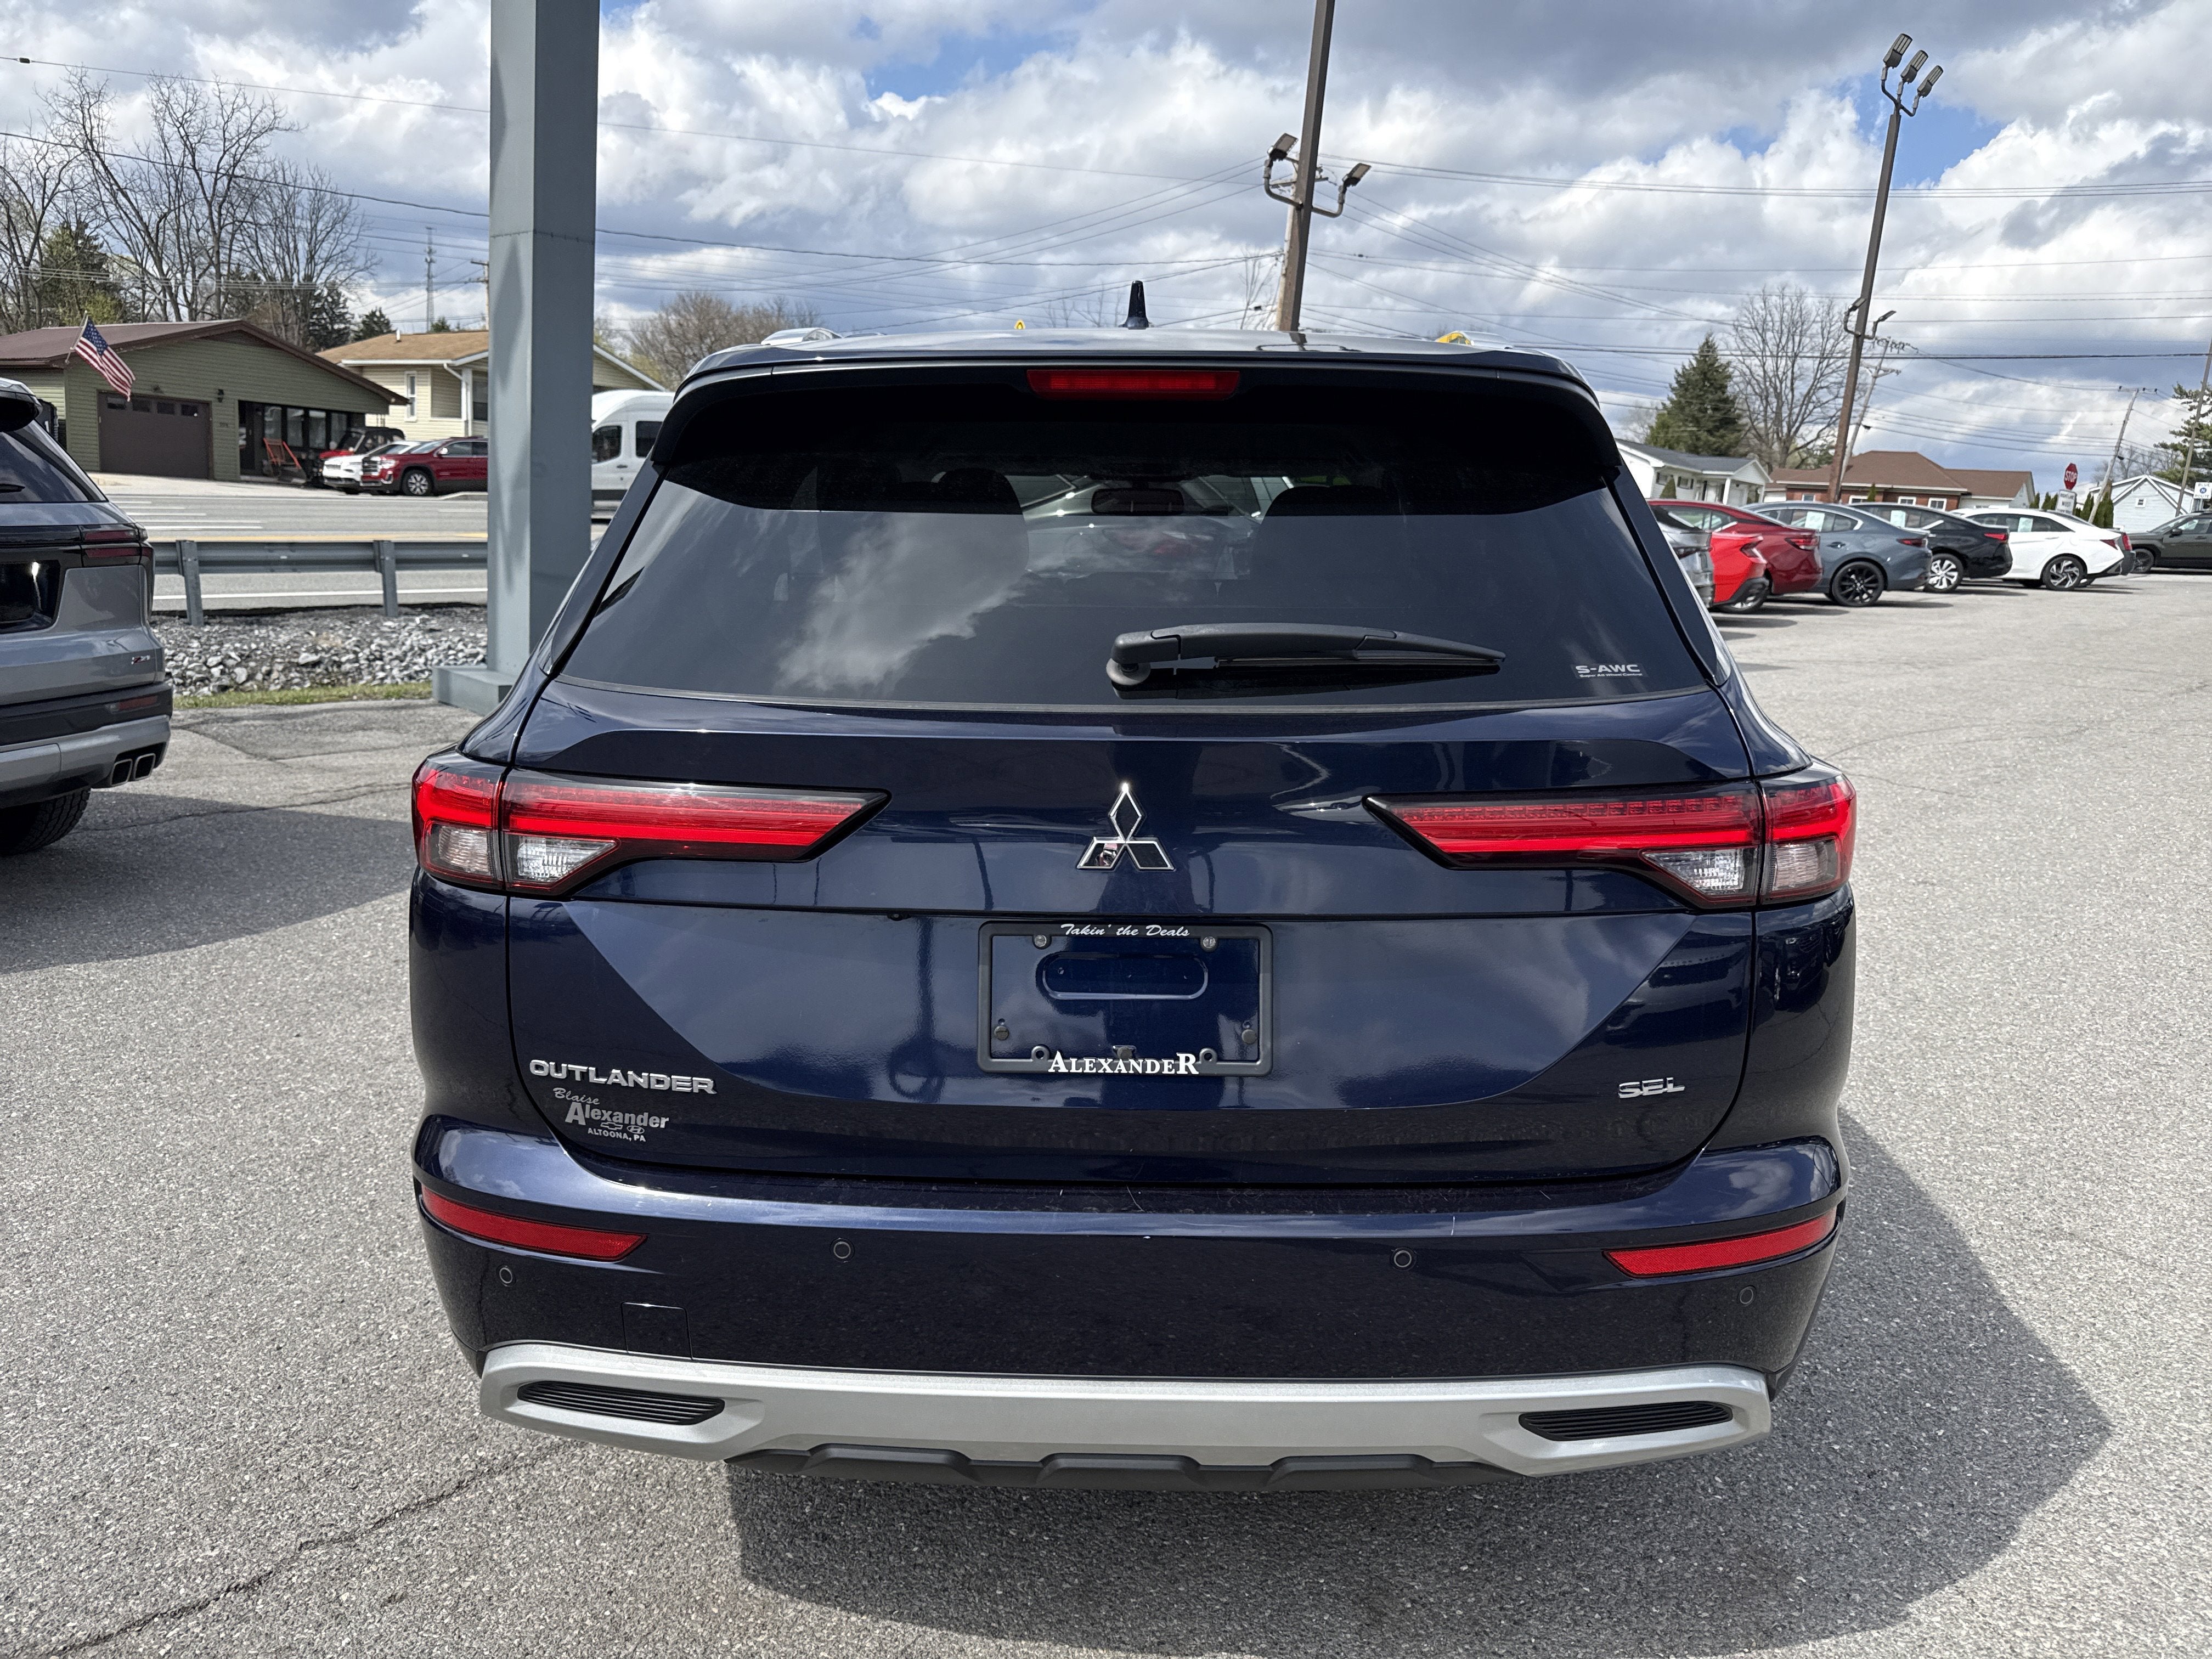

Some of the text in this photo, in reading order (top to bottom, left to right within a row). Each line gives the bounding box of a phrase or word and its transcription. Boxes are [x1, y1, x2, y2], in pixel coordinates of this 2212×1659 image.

[2064, 470, 2078, 482] STOP
[1575, 664, 1640, 674] S-AWC
[1060, 923, 1190, 936] Takin' the Deals
[1048, 1050, 1199, 1075] ALEXANDER
[529, 1059, 718, 1094] OUTLANDER
[553, 1087, 600, 1105] Blaise
[1618, 1077, 1685, 1098] SEL
[565, 1102, 670, 1128] Alexander
[588, 1128, 632, 1141] ALTOONA,
